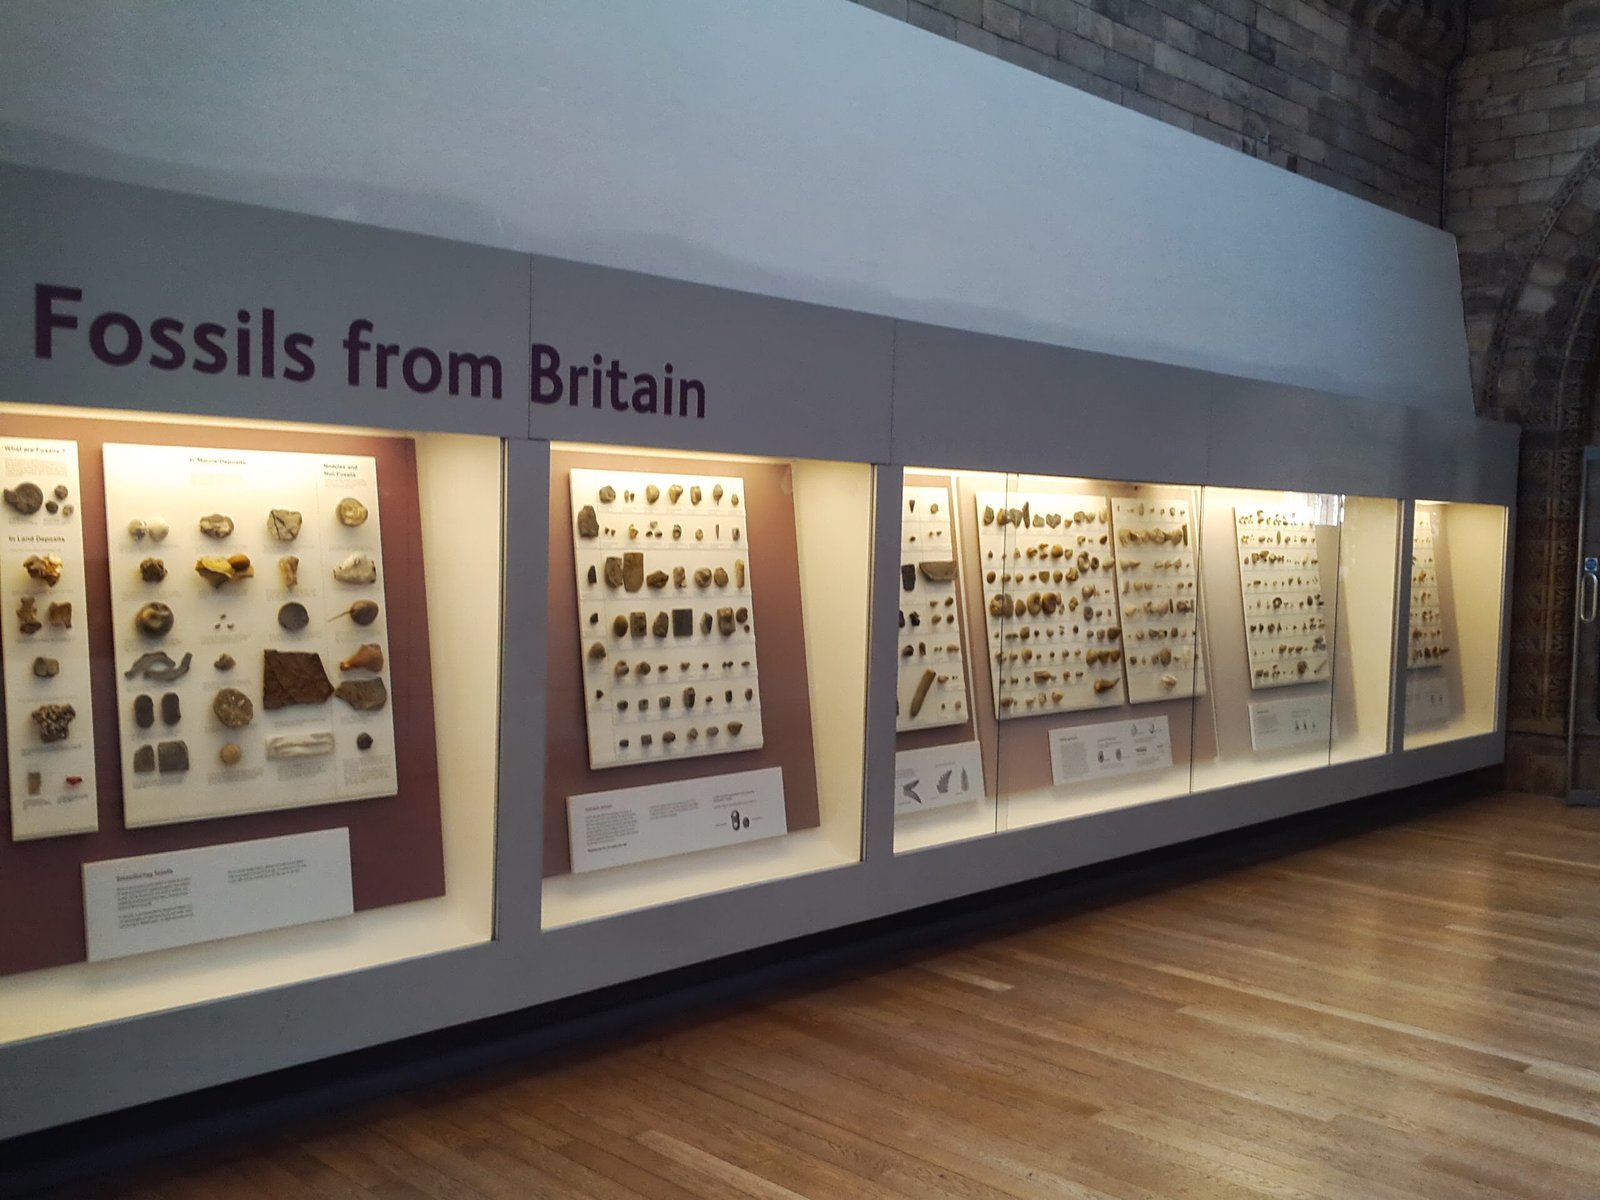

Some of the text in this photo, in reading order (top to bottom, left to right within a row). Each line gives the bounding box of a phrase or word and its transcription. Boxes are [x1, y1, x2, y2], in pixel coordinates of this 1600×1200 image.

[35, 283, 706, 418] Fossils from Britain
[35, 535, 65, 543] Deposits
